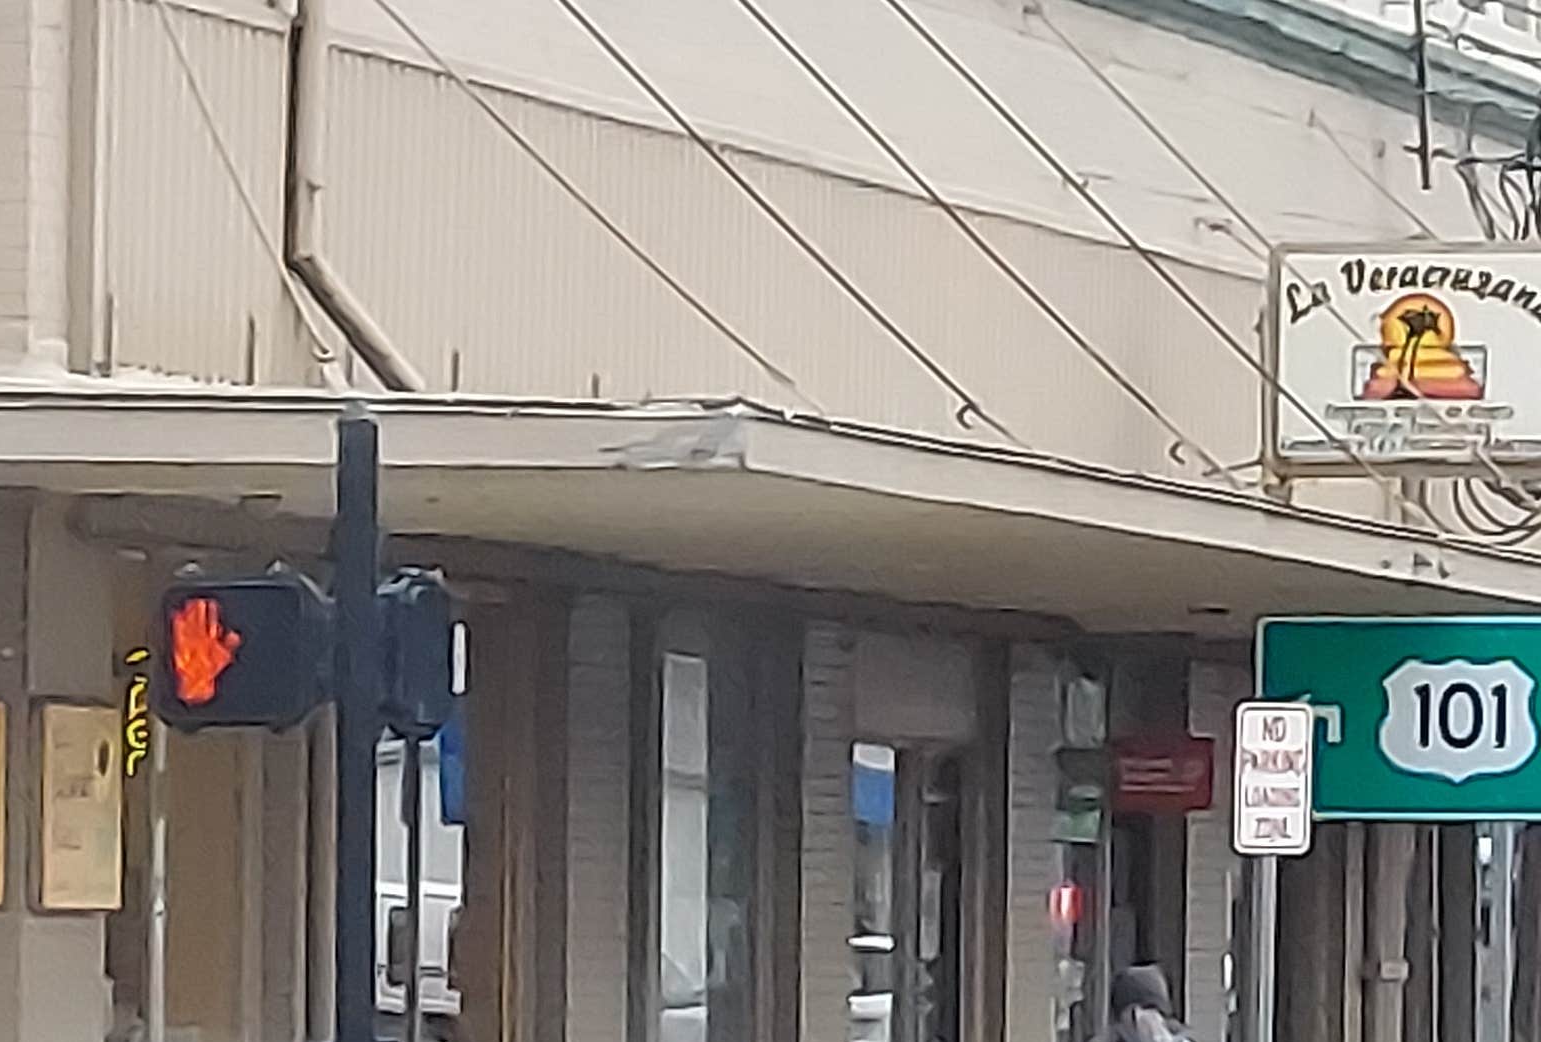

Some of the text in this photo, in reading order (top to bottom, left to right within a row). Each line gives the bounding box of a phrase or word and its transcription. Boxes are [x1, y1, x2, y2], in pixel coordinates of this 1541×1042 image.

[1286, 282, 1331, 324] La
[1262, 716, 1287, 742] NO
[1413, 682, 1507, 749] 101
